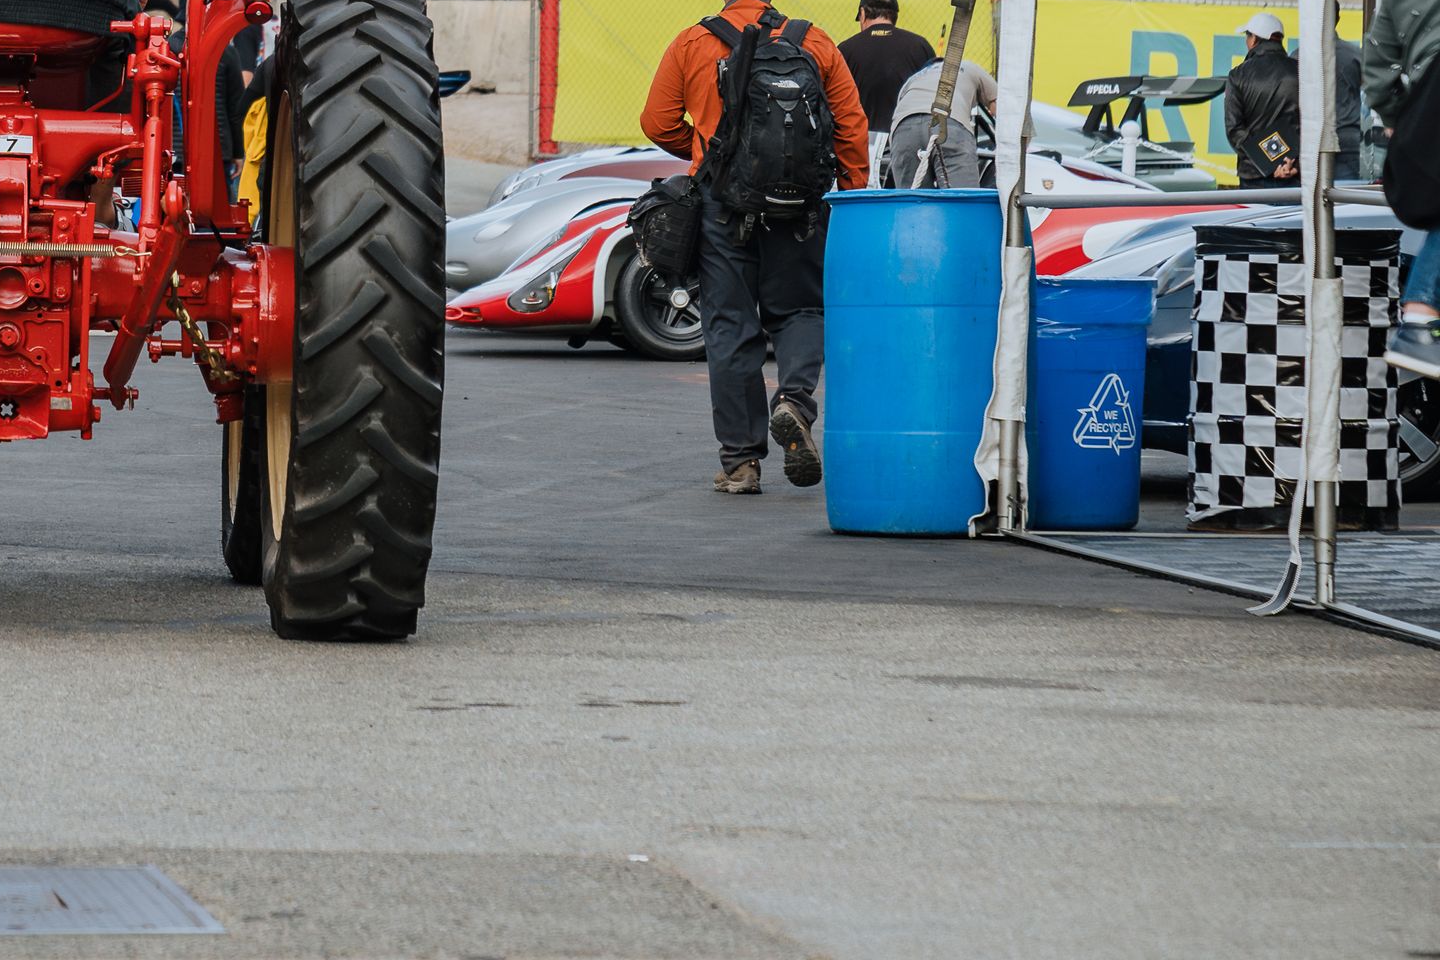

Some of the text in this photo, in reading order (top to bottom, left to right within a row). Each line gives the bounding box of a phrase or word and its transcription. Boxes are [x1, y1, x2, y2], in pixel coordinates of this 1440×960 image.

[6, 138, 19, 152] 7
[1103, 410, 1118, 420] WE
[1089, 422, 1129, 433] RECYCLE
